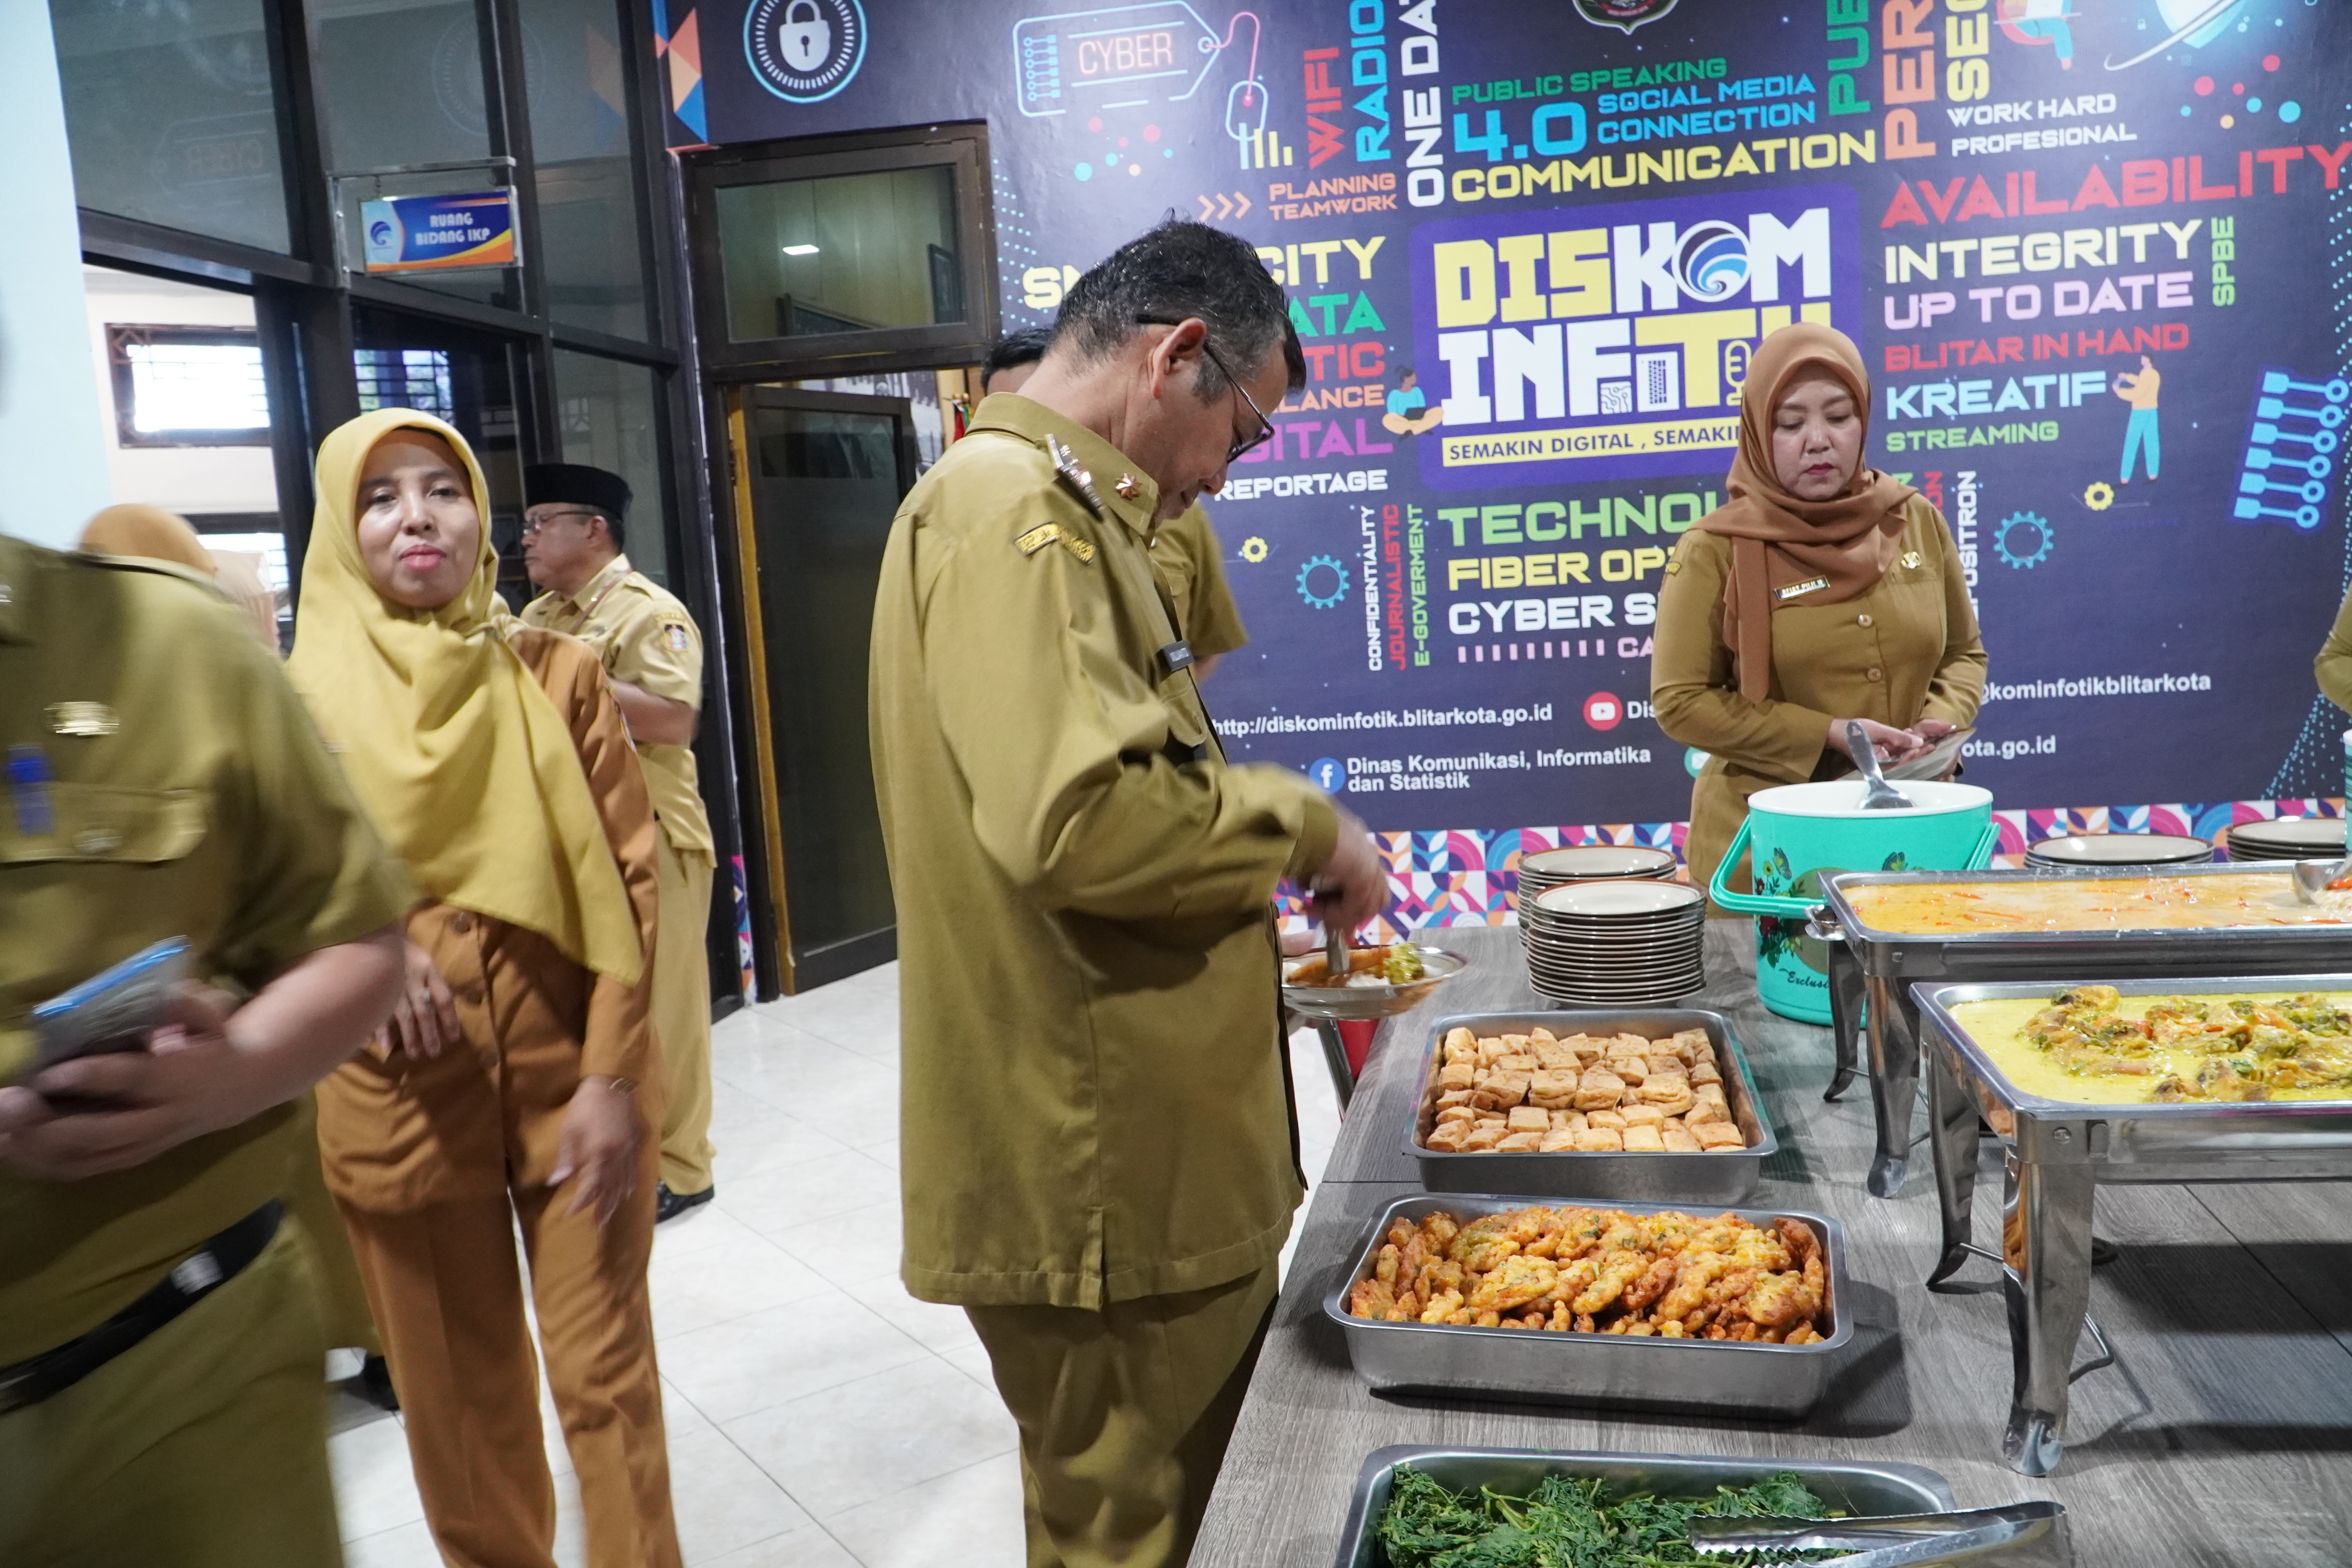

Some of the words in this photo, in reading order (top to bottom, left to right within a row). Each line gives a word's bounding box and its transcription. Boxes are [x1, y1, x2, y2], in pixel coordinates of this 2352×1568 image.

[1078, 32, 1174, 76] CYBER
[1399, 0, 1439, 76] DA
[1349, 0, 1391, 162] RADIO
[1452, 75, 1563, 105] PUBLIC
[1570, 58, 1728, 92] SPEAKING
[1597, 85, 1712, 114] SOCIAL
[1718, 74, 1816, 101] MEDIA
[1304, 48, 1345, 170] WIFI
[1597, 101, 1815, 144] CONNECTION
[1947, 101, 2033, 127] WORK
[2038, 93, 2116, 119] HARD
[1403, 87, 1444, 207] ONE
[1453, 101, 1587, 162] 4.0
[1951, 123, 2137, 157] PROFESIONAL
[1269, 173, 1396, 200] PLANNING
[1451, 129, 1875, 201] COMMUNICATION
[1881, 141, 2352, 229] AVAILABILITY
[429, 212, 474, 227] RUANG
[1269, 195, 1397, 220] TEAMWORK
[416, 230, 465, 246] BIDANG
[1885, 219, 2202, 283] INTEGRITY
[1254, 236, 1385, 286] CITY
[2211, 216, 2235, 306] SPBE
[1289, 290, 1386, 337] ATA
[1885, 292, 1956, 330] UP
[1969, 285, 2041, 322] TO
[2054, 271, 2193, 316] DATE
[1302, 342, 1385, 381] TIC
[1885, 336, 2024, 371] BLITAR
[2033, 332, 2068, 360] IN
[2078, 323, 2189, 357] HAND
[1273, 385, 1385, 413] LANCE
[1886, 371, 2106, 420] KREATIF
[1450, 438, 1543, 460] SEMAKIN
[1551, 433, 1634, 453] DIGITAL
[1886, 421, 2059, 452] STREAMING
[1214, 469, 1388, 501] REPORTAGE
[1361, 506, 1382, 671] CONFIDENTIALITY
[1383, 505, 1406, 670] JOURNALISTIC
[1407, 504, 1430, 666] E-GOVERMENT
[1448, 552, 1591, 590] FIBER
[1600, 546, 1675, 582] OP
[1449, 595, 1615, 634] CYBER
[1624, 591, 1661, 625] S
[1617, 635, 1654, 658] CA
[1211, 703, 1552, 738] http://diskominfotik.blitarkota.go.id
[1347, 757, 1402, 775] Dinas
[1408, 751, 1530, 771] Komunikasi,
[1537, 746, 1651, 767] Informatika
[1961, 735, 2056, 760] ota.go.id
[1348, 775, 1384, 792] dan
[1390, 772, 1470, 790] Statistik
